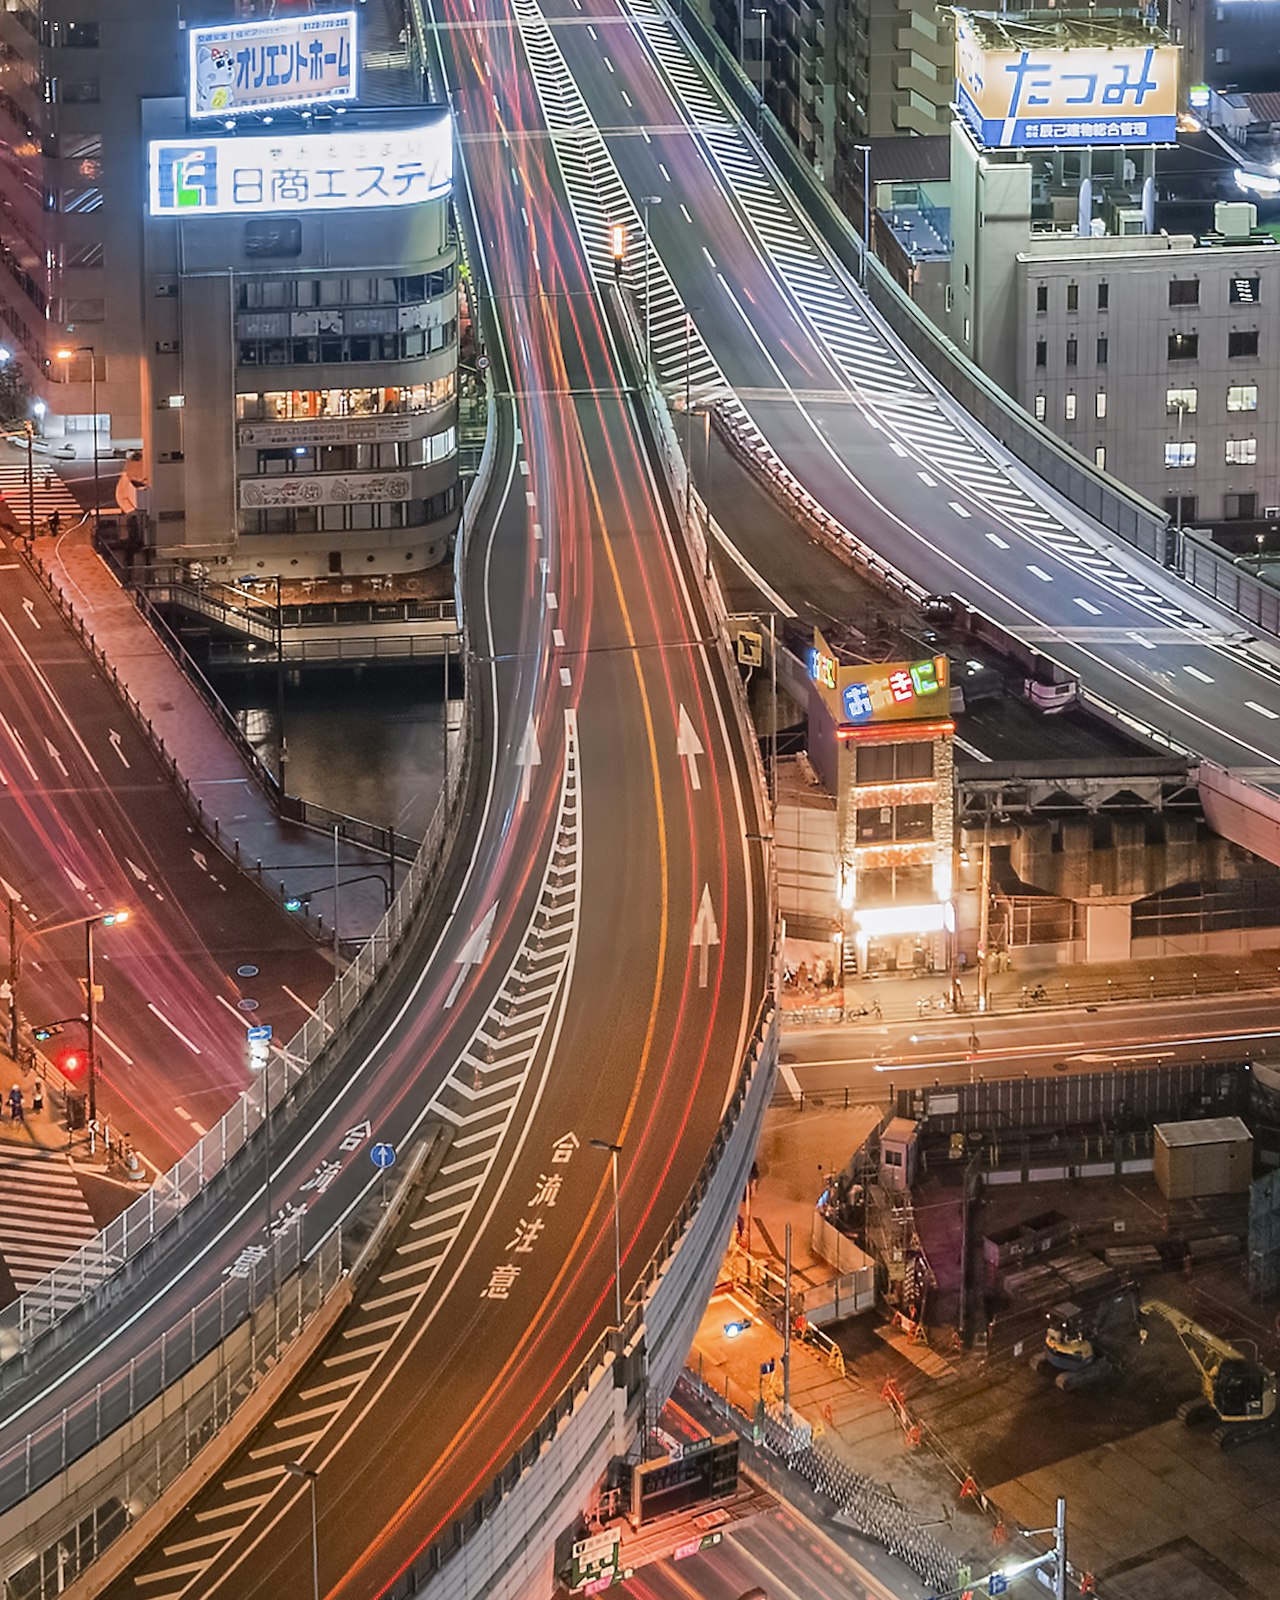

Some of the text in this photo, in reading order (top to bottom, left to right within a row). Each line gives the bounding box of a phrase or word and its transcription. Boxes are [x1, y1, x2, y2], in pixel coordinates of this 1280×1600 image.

[237, 38, 350, 90] オリエントホーム
[1004, 47, 1158, 119] たつみ
[232, 161, 451, 204] 日商エステム
[481, 1131, 581, 1300] 合流注意
